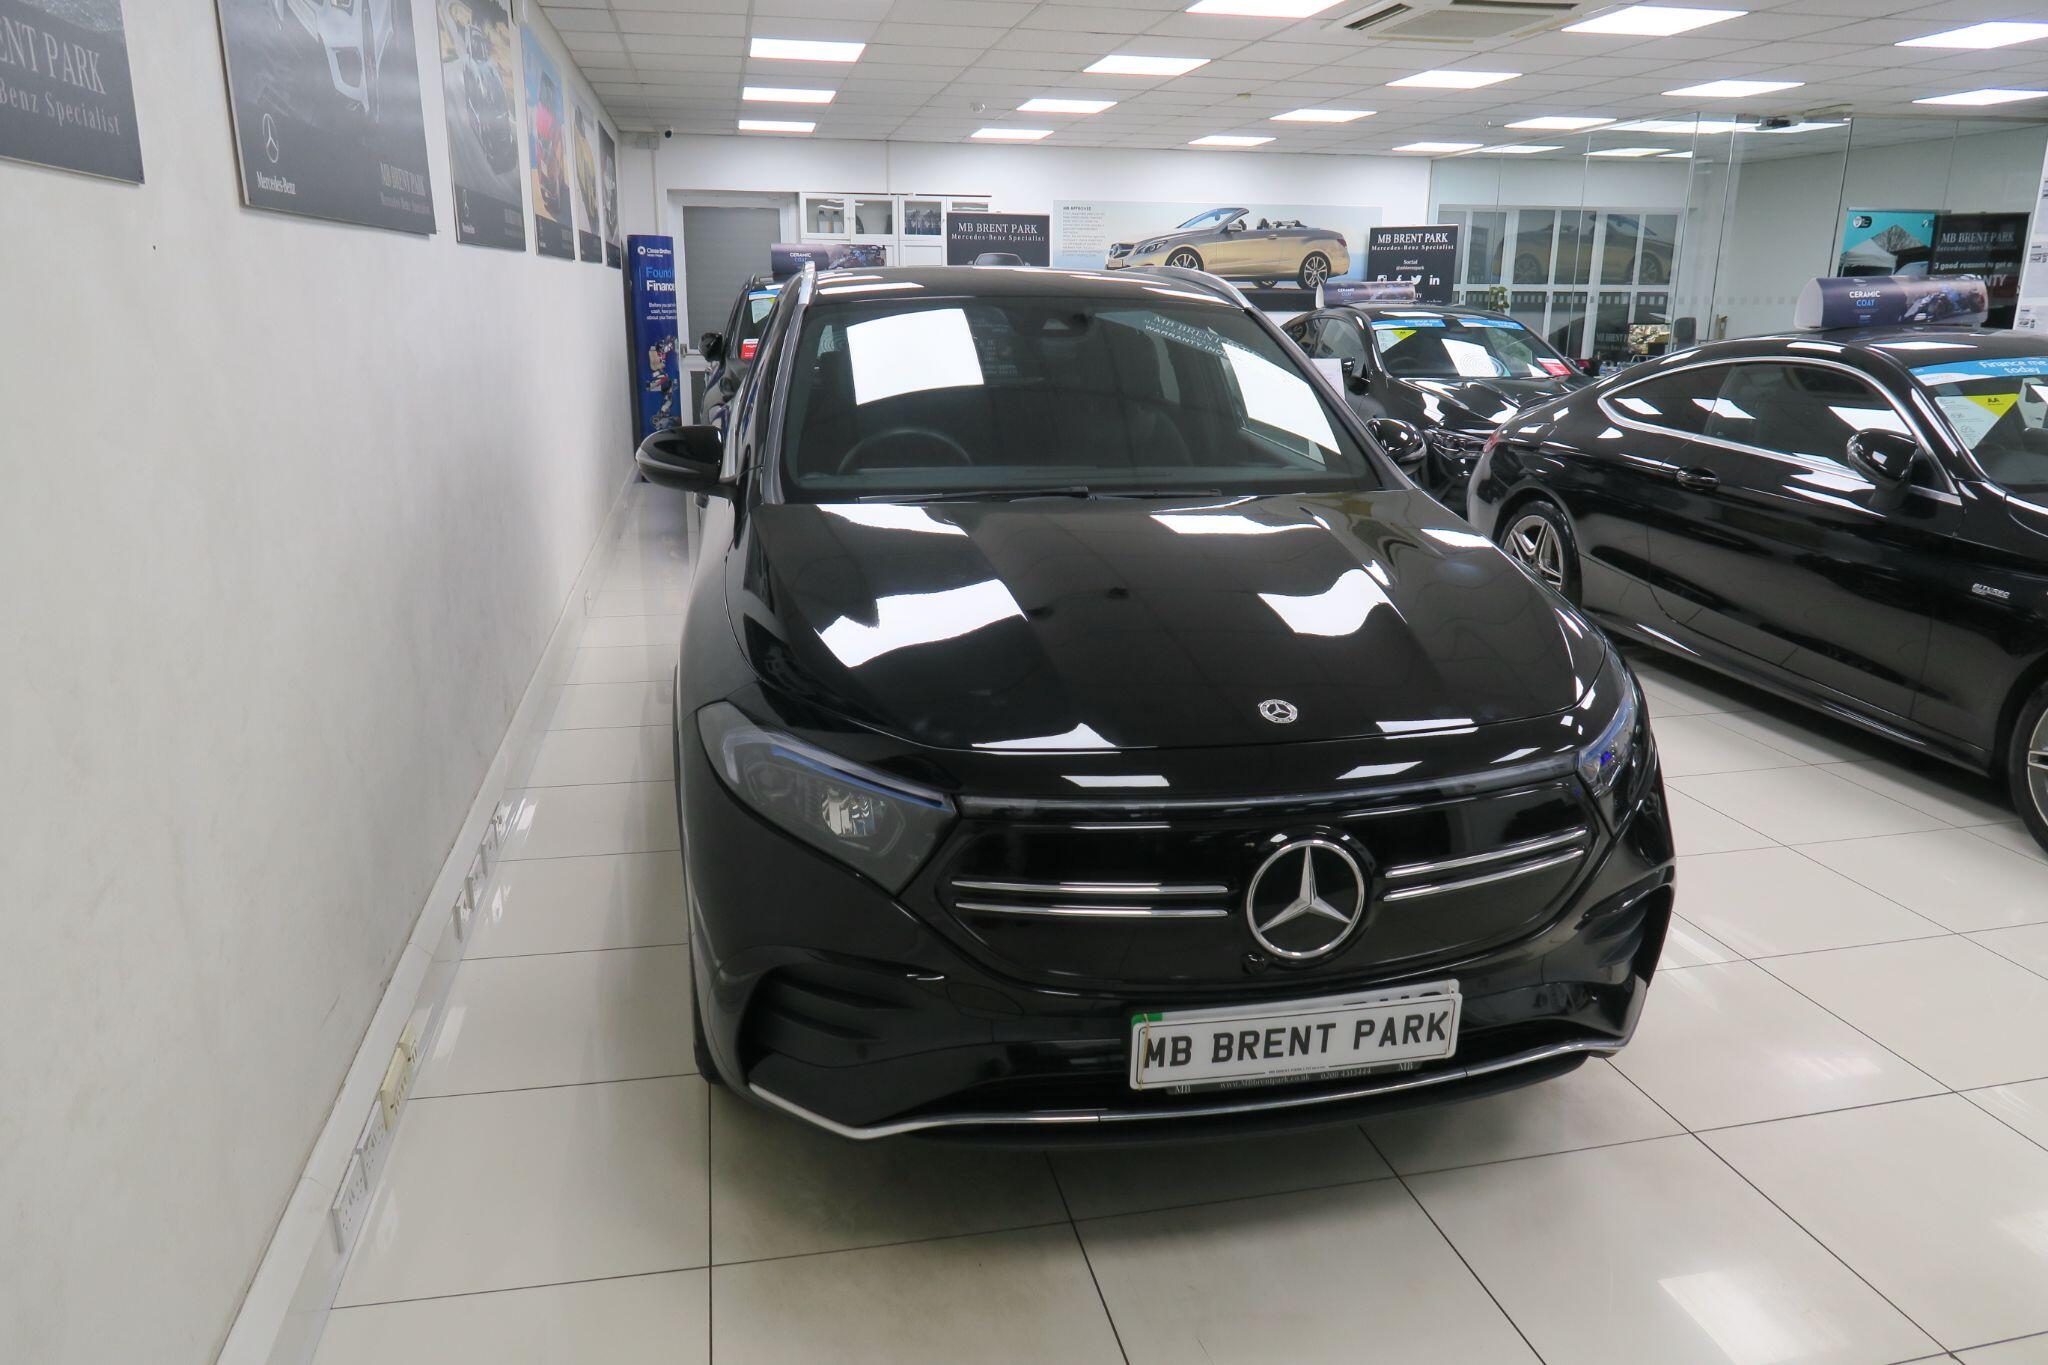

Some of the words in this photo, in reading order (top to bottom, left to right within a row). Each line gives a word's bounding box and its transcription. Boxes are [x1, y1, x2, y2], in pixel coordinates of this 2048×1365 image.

[42, 31, 107, 95] PARK
[45, 91, 121, 136] Specialist
[256, 171, 297, 195] Mercedes-Benz
[958, 223, 974, 232] MB
[976, 223, 1008, 233] BRENT
[1011, 224, 1037, 234] PARK
[1008, 234, 1045, 242] Specialist
[1378, 234, 1391, 244] MB
[1393, 233, 1423, 243] BRENT
[1424, 233, 1448, 243] PARK
[1941, 232, 1957, 243] MB
[1958, 232, 1989, 243] BRENT
[1990, 231, 2015, 242] PARK
[1940, 261, 1959, 271] good
[1849, 290, 1881, 299] CERAMIC
[1856, 299, 1876, 307] COAT
[1145, 323, 1203, 347] WARRANTY
[1178, 322, 1220, 344] BRENT
[1979, 360, 2025, 369] Finance
[2004, 366, 2041, 375] today
[1144, 1036, 1193, 1069] MB
[1211, 1023, 1336, 1064] BRENT
[1353, 1011, 1449, 1050] PARK
